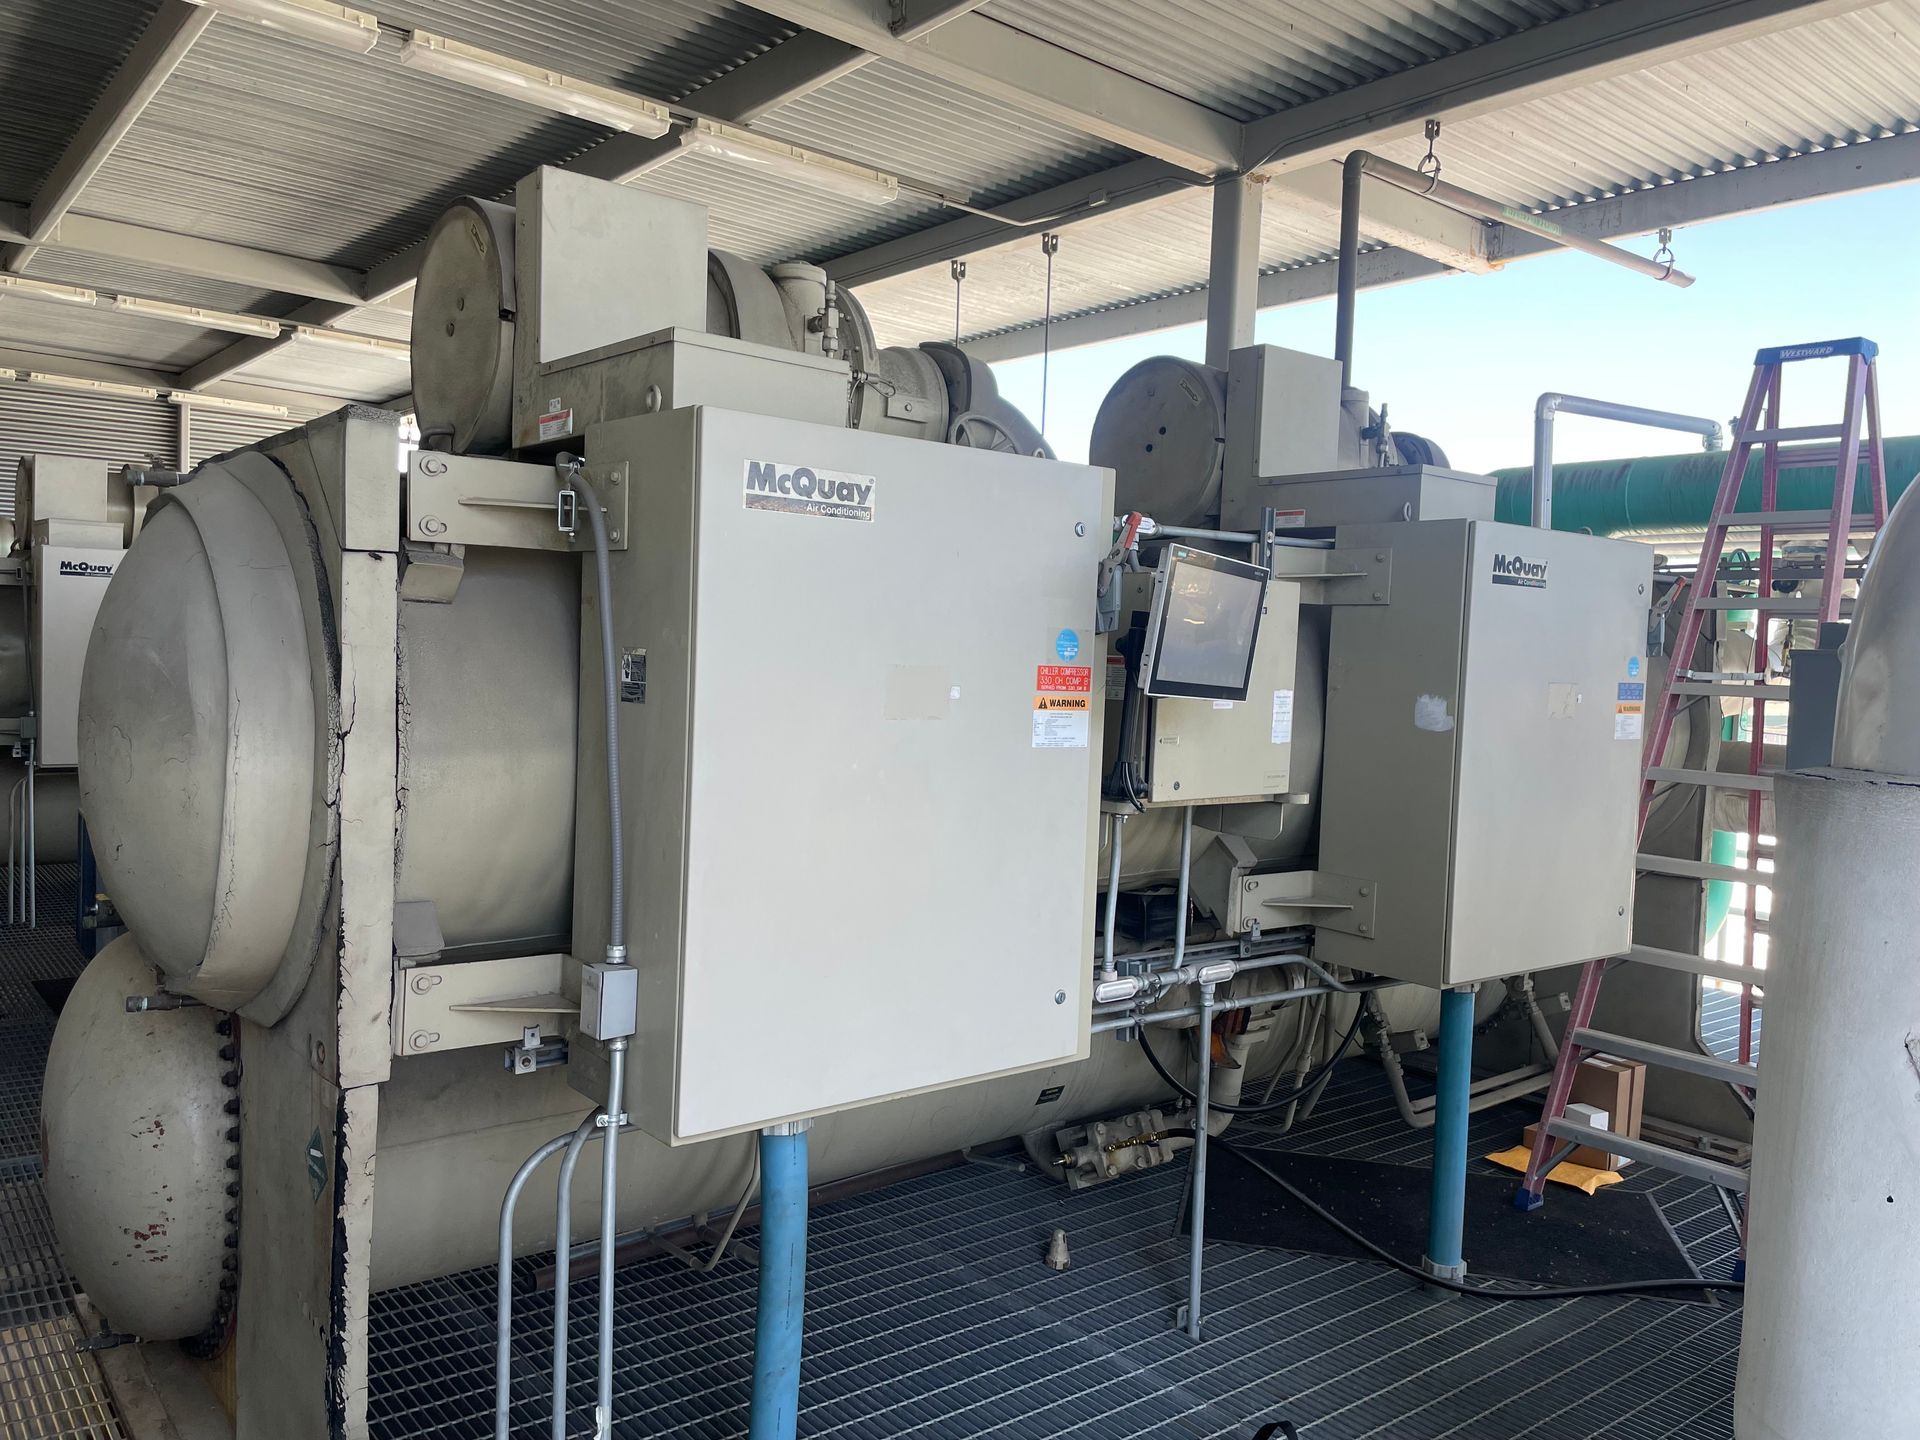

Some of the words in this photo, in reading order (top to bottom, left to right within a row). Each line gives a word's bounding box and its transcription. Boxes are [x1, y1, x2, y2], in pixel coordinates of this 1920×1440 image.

[1781, 347, 1833, 358] WESTWARD
[806, 503, 819, 513] Air
[820, 504, 872, 519] Conditioning
[60, 561, 113, 572] McQuay
[1040, 666, 1059, 676] CHILLER
[1060, 667, 1089, 676] COMPRESSOR
[1039, 676, 1052, 685] 330
[1065, 676, 1082, 685] COMP
[1049, 699, 1086, 708] WARNING
